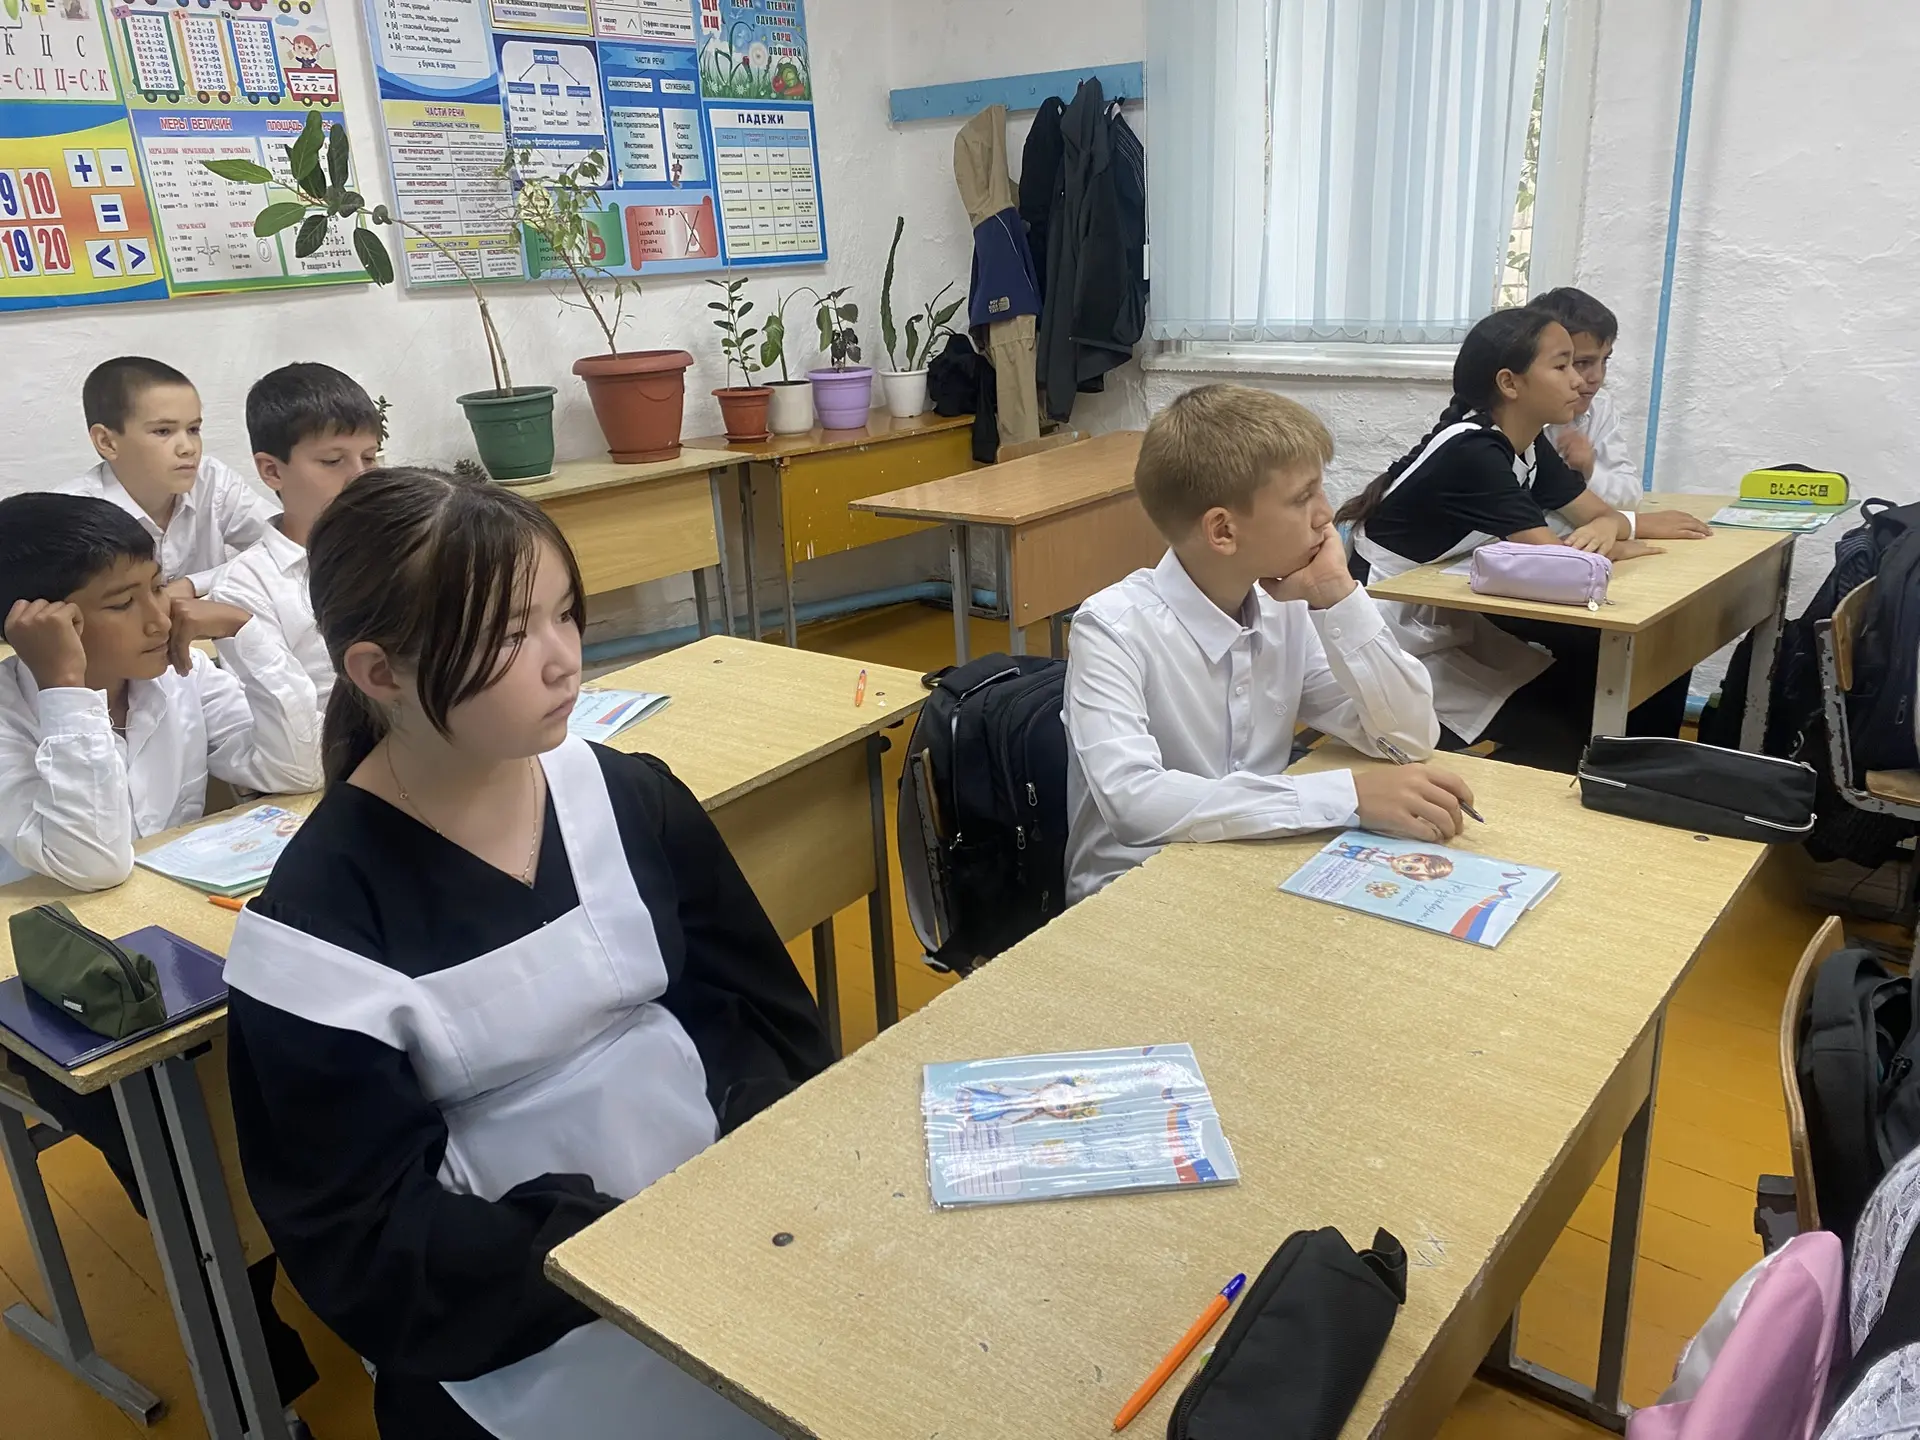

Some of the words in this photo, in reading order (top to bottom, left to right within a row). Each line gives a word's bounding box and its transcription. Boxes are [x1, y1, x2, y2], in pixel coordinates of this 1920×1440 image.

[772, 32, 791, 42] БОРЩ
[4, 33, 15, 55] К
[40, 34, 53, 61] Ц
[77, 35, 87, 57] С
[769, 47, 801, 57] ОВОЩНОЙ
[635, 56, 651, 64] ЧАСТИ
[652, 57, 665, 65] РЕЧИ
[665, 83, 691, 91] СЛУЖЕБНЫЕ
[425, 107, 446, 116] ЧАСТИ
[446, 108, 465, 117] РЕЧИ
[160, 117, 189, 130] МЕРЫ
[191, 117, 233, 130] ВЕЛИЧИН
[738, 114, 784, 125] ПАДЕЖИ
[266, 119, 303, 132] ПЛОЩАДЬ
[0, 172, 18, 216] 9
[23, 171, 56, 214] 10
[655, 208, 679, 217] м.р.
[2, 229, 34, 272] 19
[37, 227, 71, 270] 20
[1770, 482, 1819, 497] BLACK
